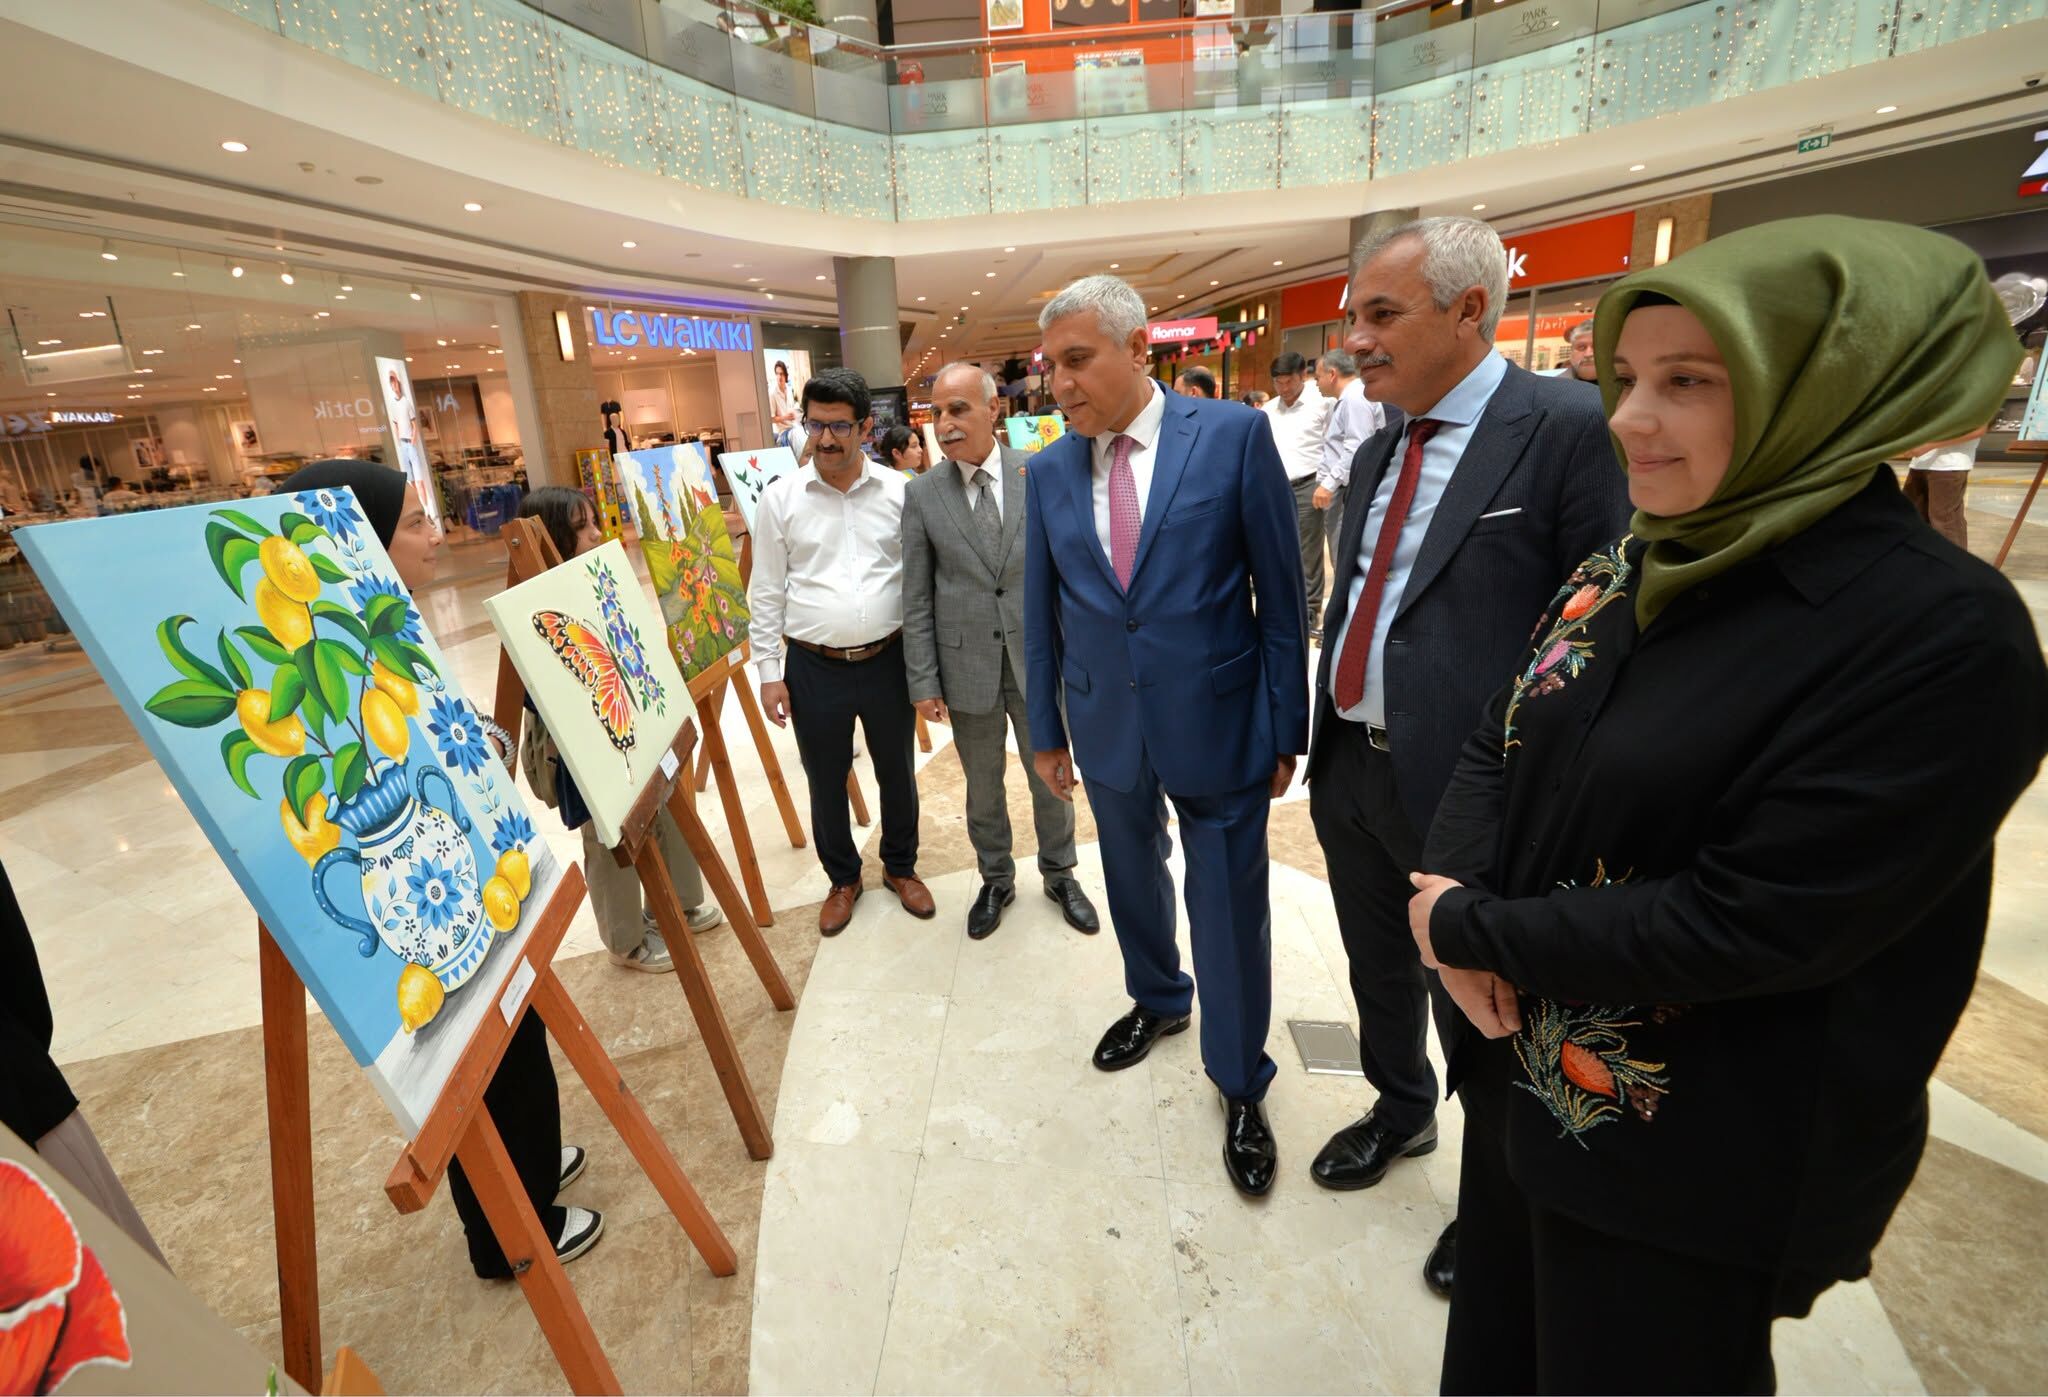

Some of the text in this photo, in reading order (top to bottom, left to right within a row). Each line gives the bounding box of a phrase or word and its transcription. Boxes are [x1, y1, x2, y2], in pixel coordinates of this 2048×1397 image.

[1522, 7, 1548, 24] PARK
[593, 310, 639, 346] LC
[1151, 326, 1196, 340] flormar
